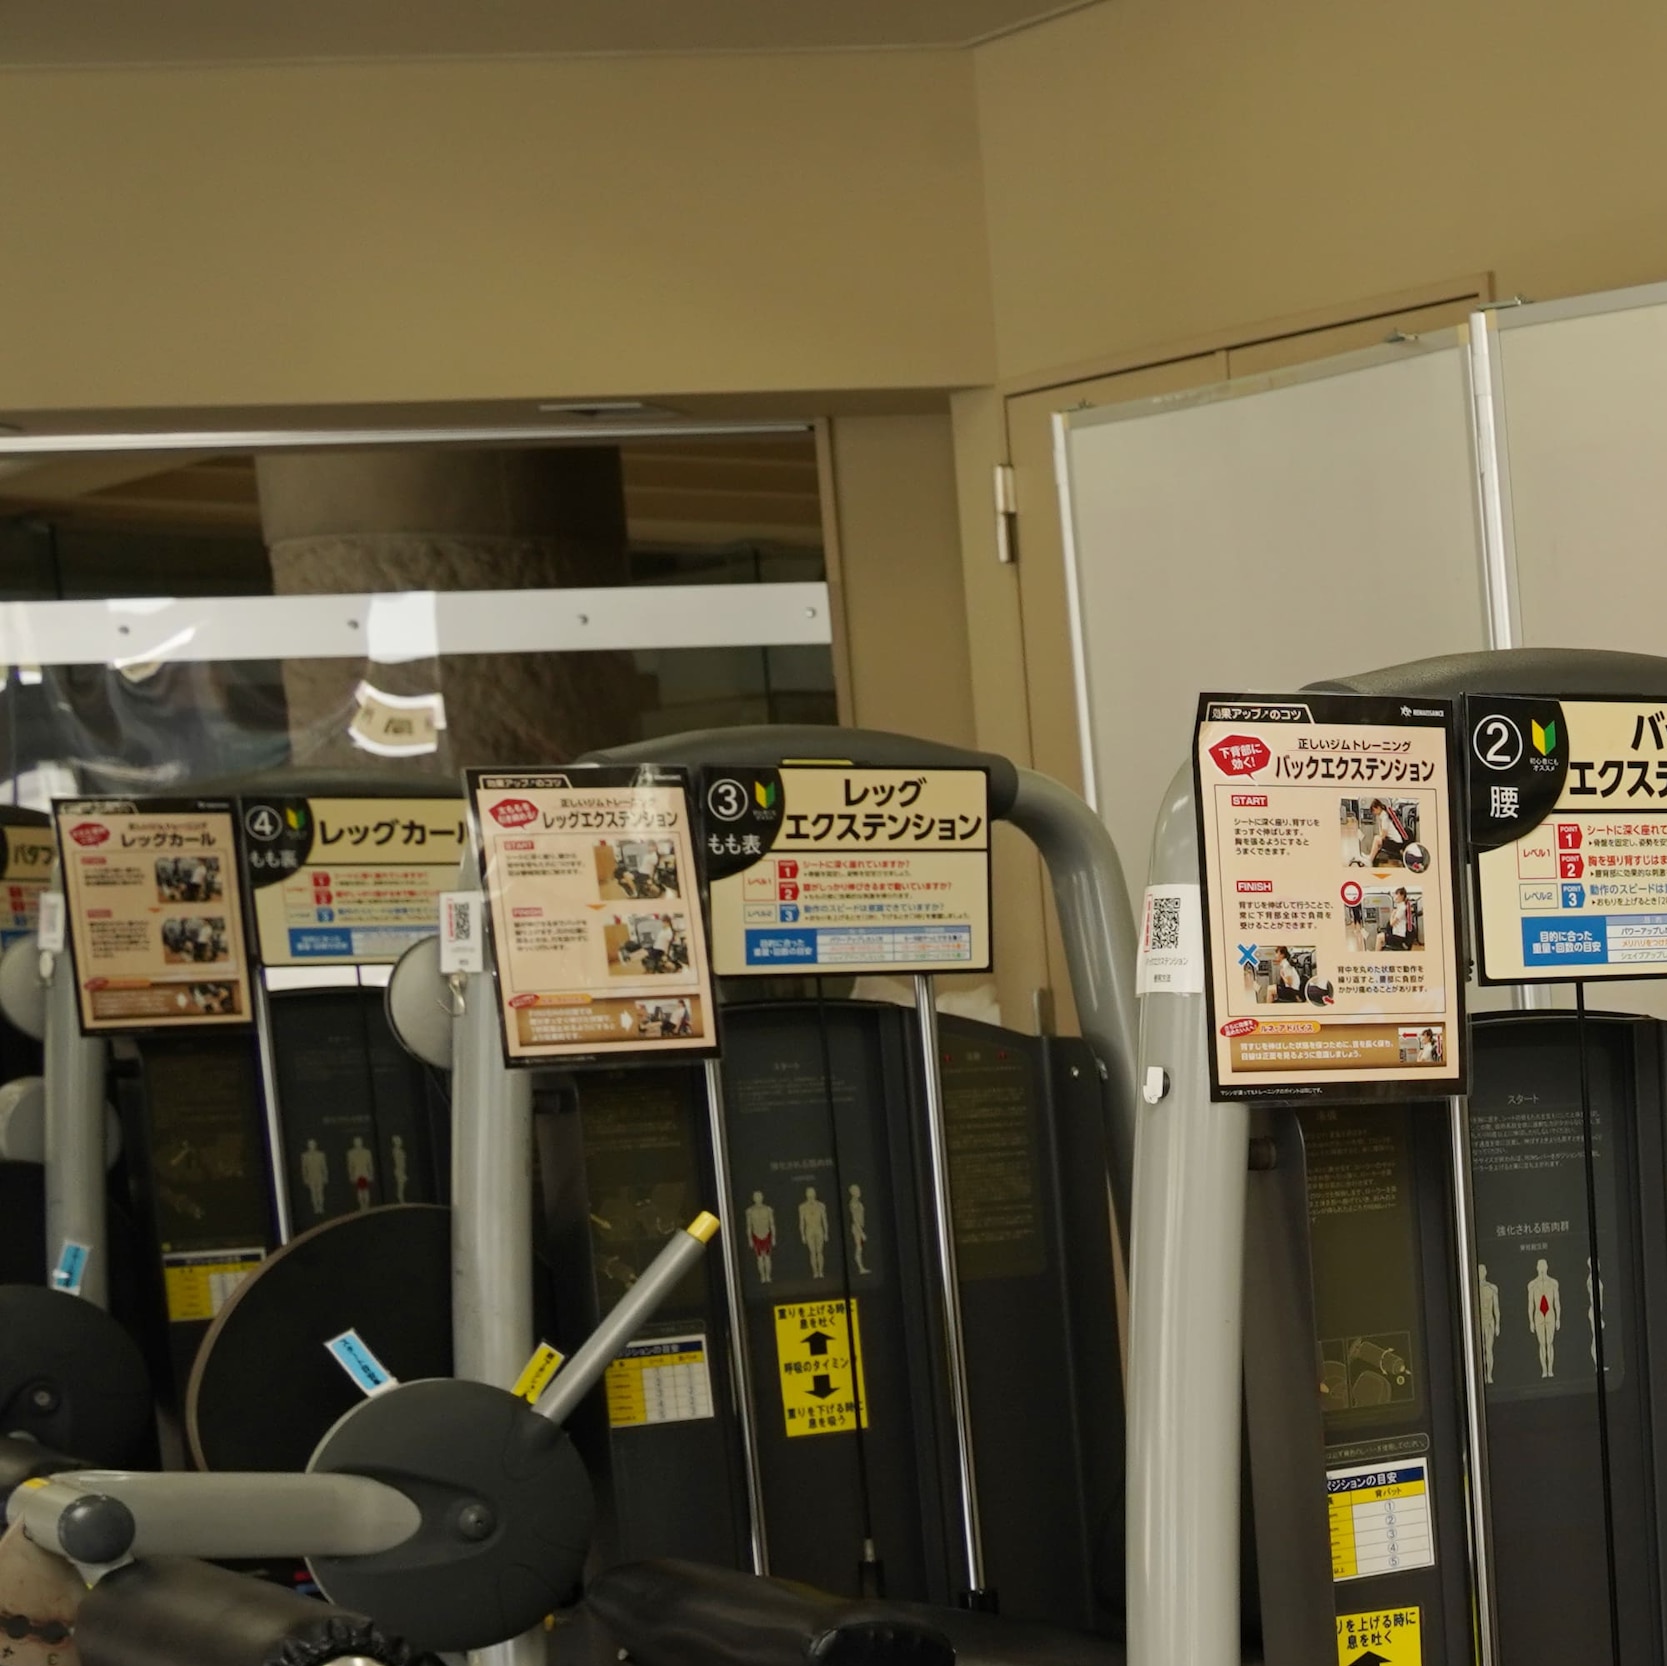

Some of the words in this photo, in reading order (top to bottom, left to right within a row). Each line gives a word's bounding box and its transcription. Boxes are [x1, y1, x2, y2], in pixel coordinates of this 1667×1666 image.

[1298, 738, 1412, 753] 正しいジムトレーニング
[1275, 756, 1435, 782] バックエクステンション
[844, 776, 927, 807] レッグ
[1233, 796, 1267, 806] START
[1490, 785, 1520, 819] 腰
[543, 812, 678, 830] レッグエクステンション
[786, 814, 982, 841] エクステンション
[121, 833, 216, 848] レッグカール
[707, 833, 762, 855] もも表
[1565, 834, 1573, 847] 1
[784, 868, 791, 877] 1
[1567, 863, 1576, 877] 2
[1238, 882, 1272, 892] FINISH
[785, 890, 793, 900] 2
[1568, 893, 1577, 907] 3
[785, 911, 793, 922] 3
[1507, 1094, 1539, 1105] スタート
[1496, 1221, 1570, 1237] 強化される筋肉群
[784, 1357, 850, 1375] 呼吸のタイミン
[1347, 1630, 1392, 1650] 息を吐く
